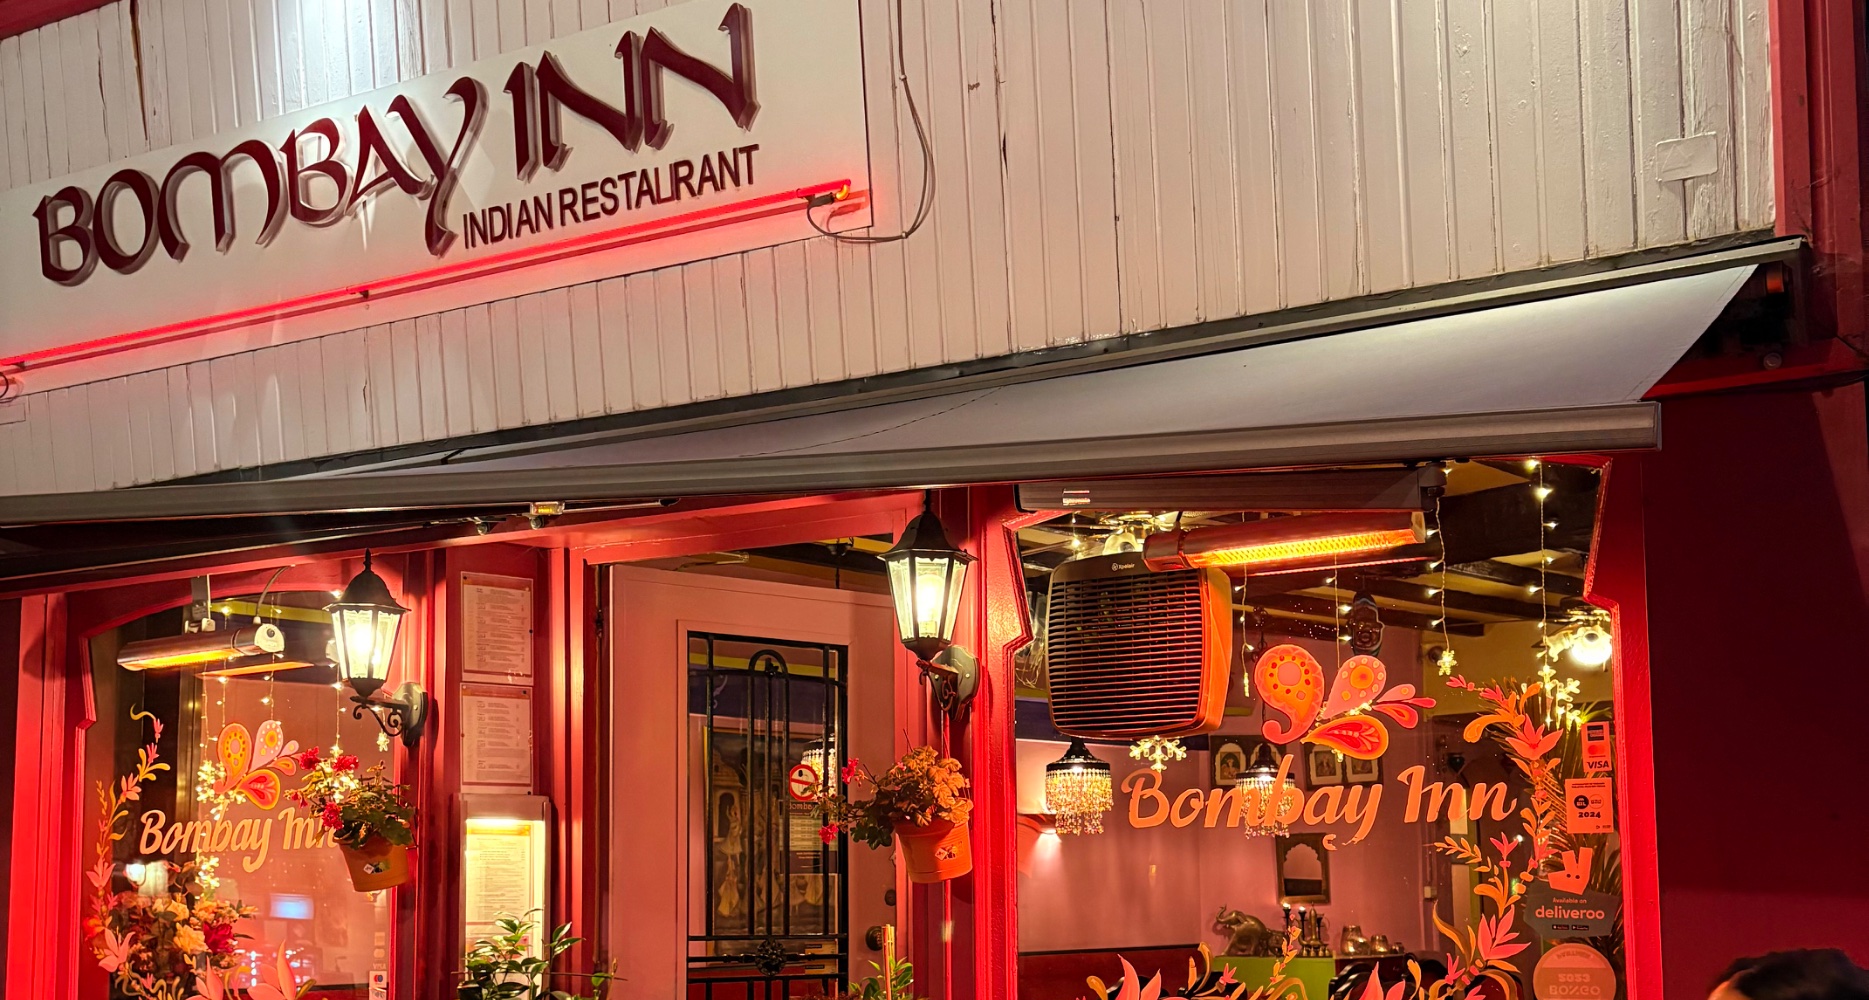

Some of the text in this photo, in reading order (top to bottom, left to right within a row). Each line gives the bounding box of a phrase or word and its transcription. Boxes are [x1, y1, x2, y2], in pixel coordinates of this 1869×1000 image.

[32, 2, 761, 286] BOMBAY INN
[462, 143, 760, 249] INDIAN RESTAURANT
[1587, 760, 1610, 769] VISA
[139, 800, 272, 873] Bombay
[1121, 753, 1518, 851] Bombay Inn
[1535, 905, 1605, 920] deliveroo
[1552, 896, 1578, 904] Available
